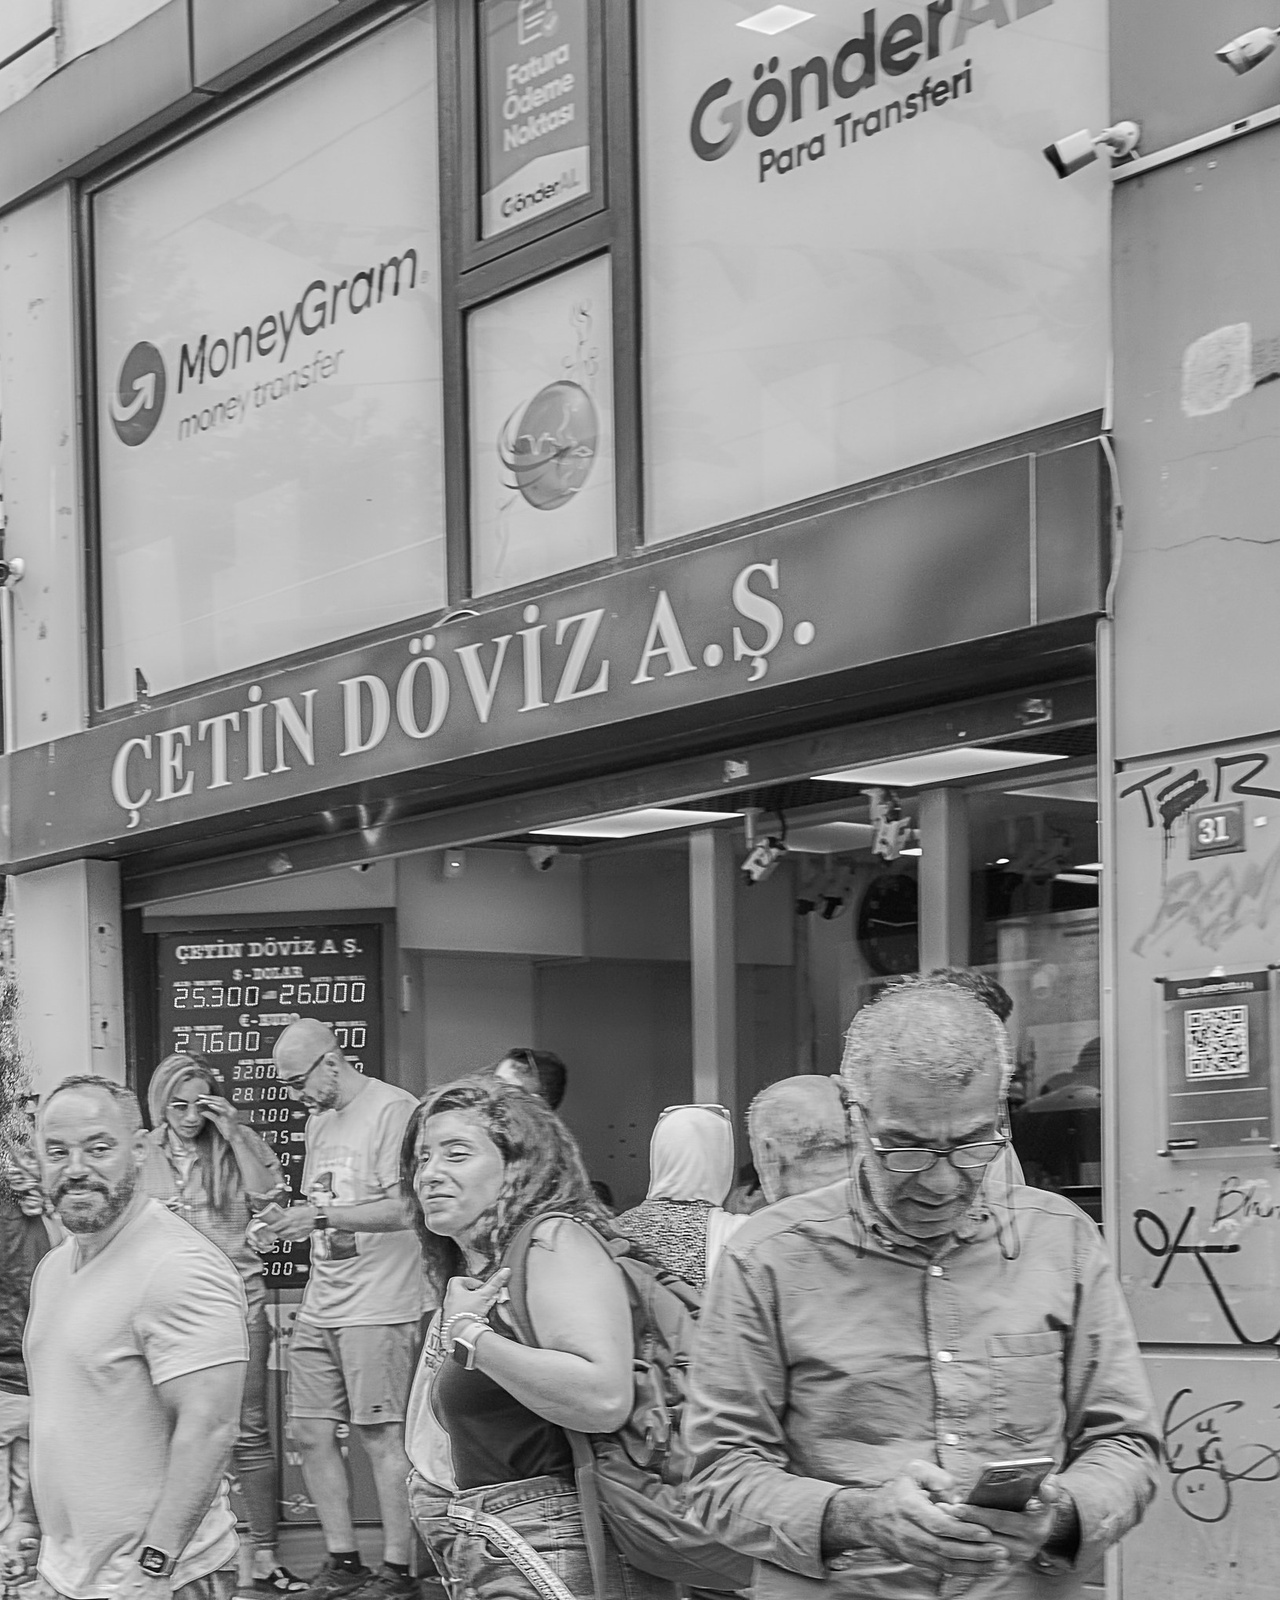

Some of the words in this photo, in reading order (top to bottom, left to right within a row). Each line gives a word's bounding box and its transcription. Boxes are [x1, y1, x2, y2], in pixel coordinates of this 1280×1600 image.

[506, 43, 570, 90] Fatura
[690, 0, 1054, 162] GönderA
[503, 73, 575, 120] Ödeme
[759, 134, 826, 182] Para
[835, 58, 972, 148] Transferi
[503, 103, 575, 151] Noktası
[500, 168, 581, 218] GönderAL
[177, 248, 417, 394] MoneyGram
[178, 391, 251, 441] money
[254, 349, 344, 409] transfer
[111, 685, 319, 829] ÇETİN
[338, 603, 610, 757] DÖVİZ
[631, 558, 816, 684] A.Ş.
[1198, 816, 1230, 845] 31
[174, 986, 260, 1009] 25.300
[280, 982, 366, 1005] 26.000
[174, 1031, 261, 1054] 27.600
[232, 1065, 282, 1080] 32.00
